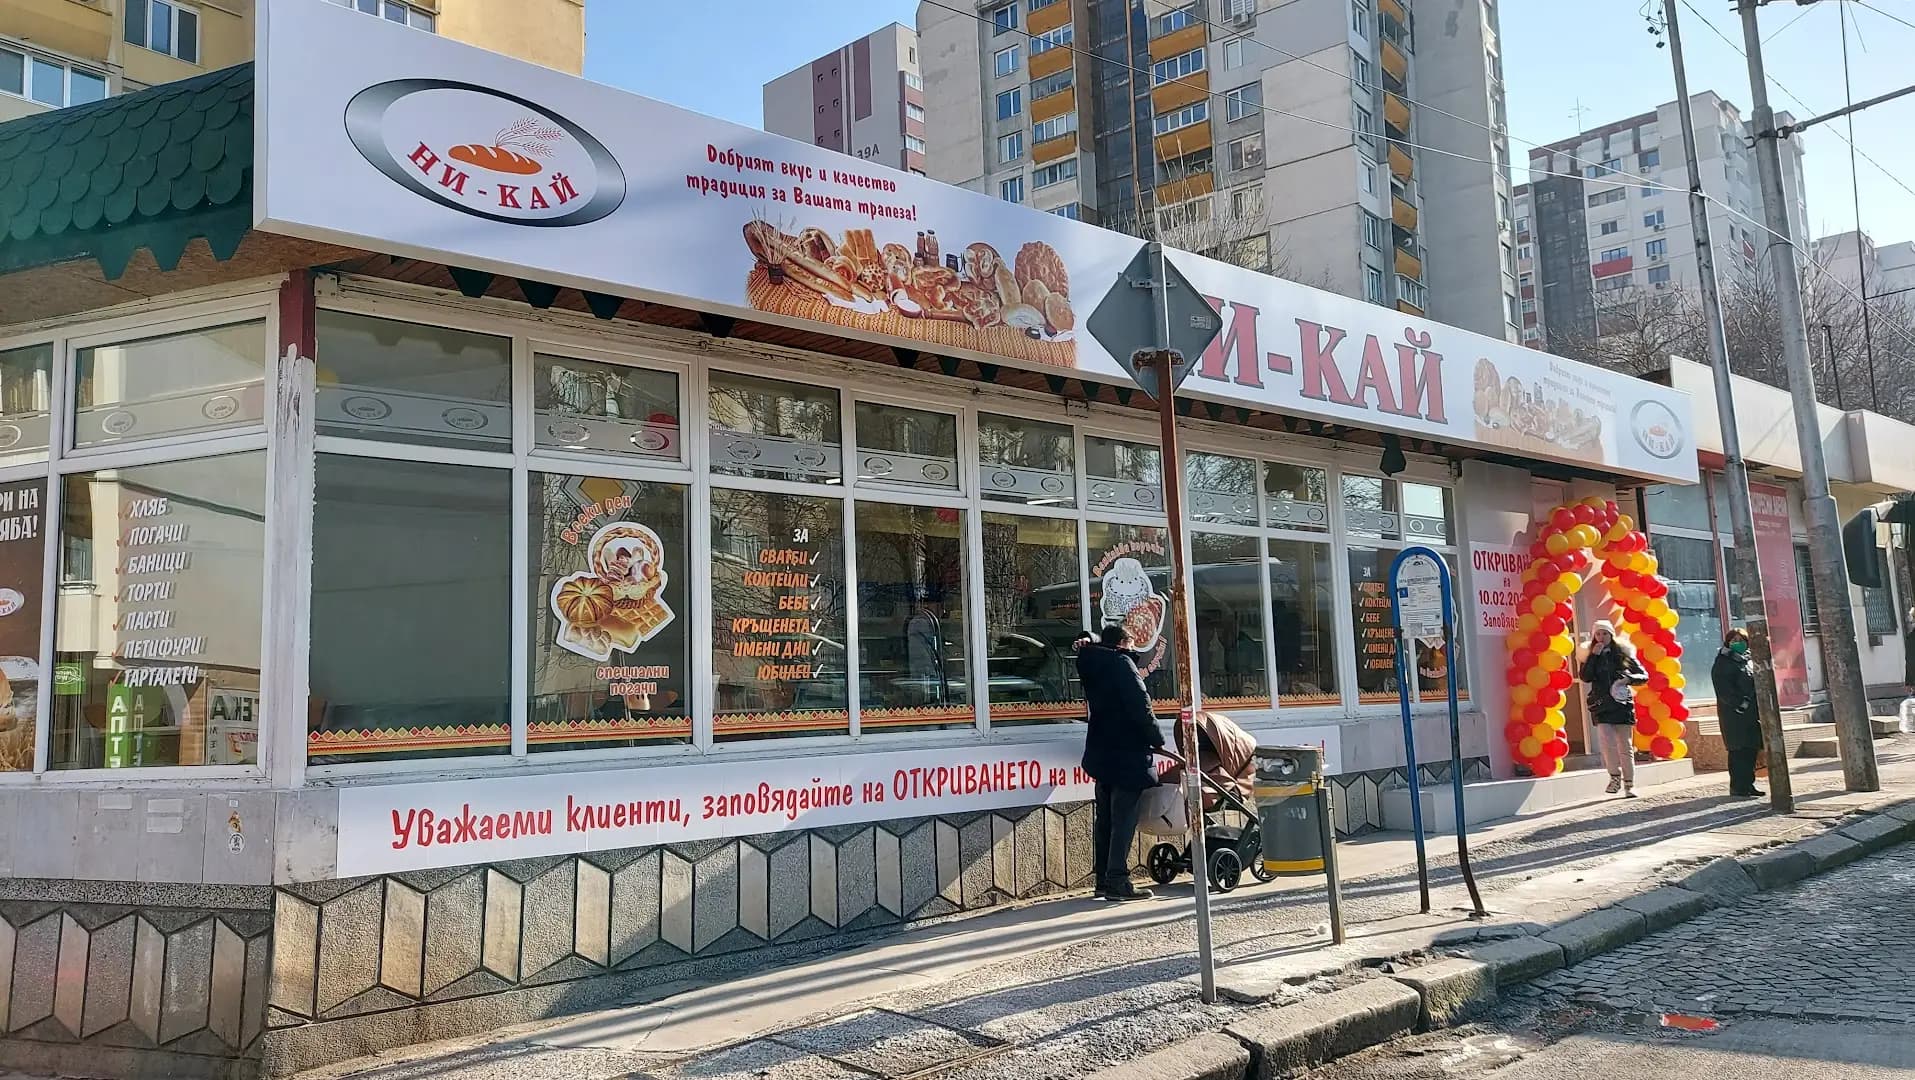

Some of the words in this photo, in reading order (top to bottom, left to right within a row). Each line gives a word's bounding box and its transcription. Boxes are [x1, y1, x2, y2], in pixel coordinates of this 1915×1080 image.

[407, 141, 579, 209] НИ-КАЙ
[707, 144, 774, 173] Добрият
[781, 162, 812, 183] вкус
[819, 169, 827, 181] и
[834, 170, 896, 193] качество
[686, 174, 766, 199] традиция
[772, 187, 786, 202] за
[794, 187, 851, 212] Вашата
[858, 201, 917, 221] трапеза!
[1188, 293, 1449, 425] И-КАЙ
[19, 488, 38, 510] НА
[129, 498, 167, 519] ХЛЯБ
[561, 502, 604, 545] Всеки
[604, 496, 632, 516] ден
[129, 523, 183, 546] ПОГАЧИ
[793, 528, 809, 543] ЗА
[128, 552, 186, 574] БАНИЦИ
[760, 549, 808, 566] СВАТБИ
[1473, 550, 1530, 574] ОТКРИВАН
[743, 566, 809, 588] КОКТЕЙЛИ
[1503, 577, 1511, 588] на
[128, 581, 170, 602] ТОРТИ
[779, 596, 809, 611] БЕБЕ
[126, 610, 169, 630] ПАСТИ
[732, 618, 810, 636] КРЪЩЕНЕТА
[1365, 613, 1380, 623] БЕБЕ
[124, 636, 202, 659] ПЕТИФУРИ
[733, 641, 780, 657] ИМЕНИ
[782, 641, 810, 660] ДНИ
[124, 665, 199, 688] ТАРТАЛЕТИ
[596, 665, 669, 680] специални
[757, 664, 811, 681] ЮБИЛЕИ
[609, 681, 657, 696] погачи
[392, 803, 552, 850] Уважаеми
[566, 795, 690, 832] клиенти,
[703, 776, 854, 820] заповядайте
[863, 780, 884, 803] на
[893, 759, 1041, 801] ОТКРИВАНЕТО
[1049, 768, 1066, 787] на
[1074, 766, 1096, 785] но
